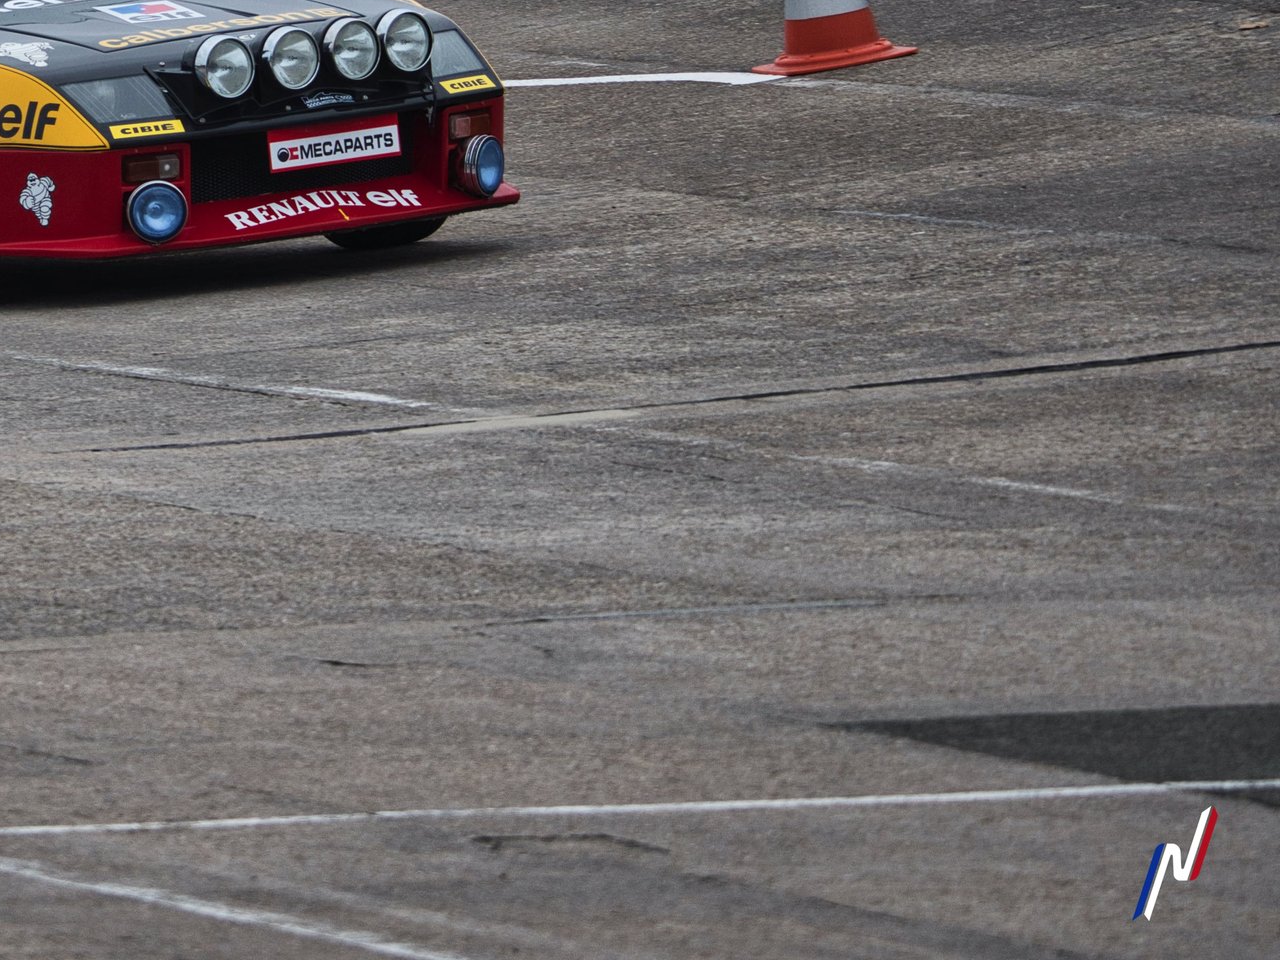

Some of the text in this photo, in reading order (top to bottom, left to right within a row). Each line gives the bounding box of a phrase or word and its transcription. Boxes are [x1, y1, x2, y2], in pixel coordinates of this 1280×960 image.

[98, 8, 314, 49] calberson
[299, 132, 394, 160] MECAPARTS
[224, 189, 422, 230] RENAULT elf
